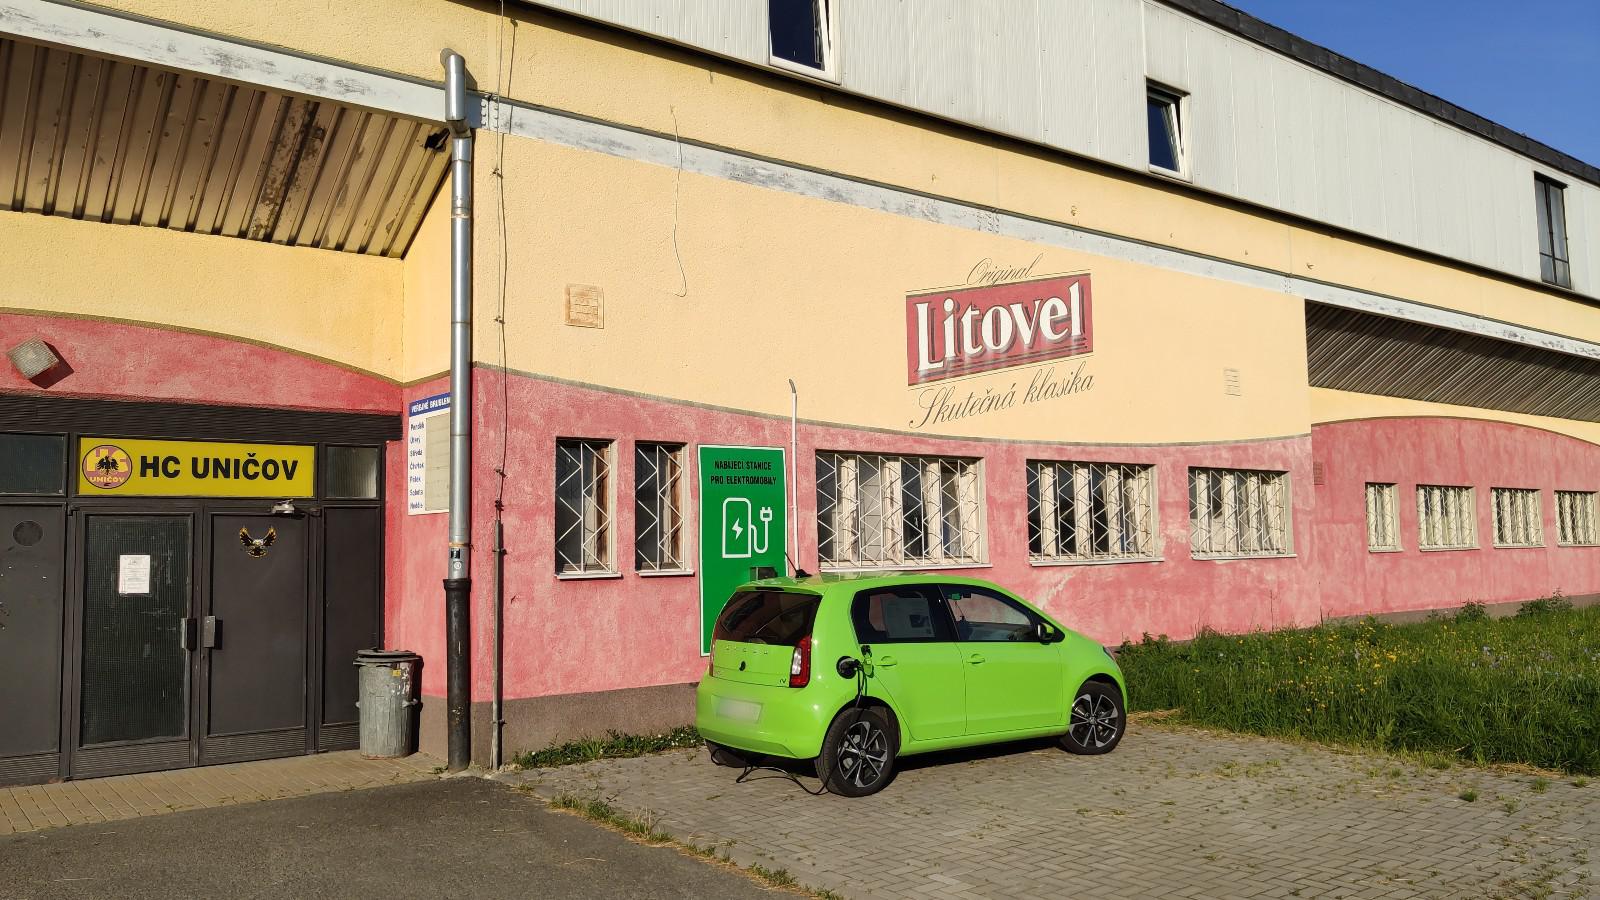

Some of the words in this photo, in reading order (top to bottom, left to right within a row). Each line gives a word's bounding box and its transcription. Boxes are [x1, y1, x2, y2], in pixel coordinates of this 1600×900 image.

[966, 252, 1043, 286] Original
[914, 280, 1085, 372] Litovel
[908, 382, 1016, 429] Skutečná
[1022, 360, 1095, 405] klasika
[139, 455, 181, 479] HC
[191, 453, 299, 481] UNIČOV
[710, 475, 724, 485] PRO
[726, 476, 777, 485] ELEKTROMOBILY
[746, 461, 772, 470] STANICE
